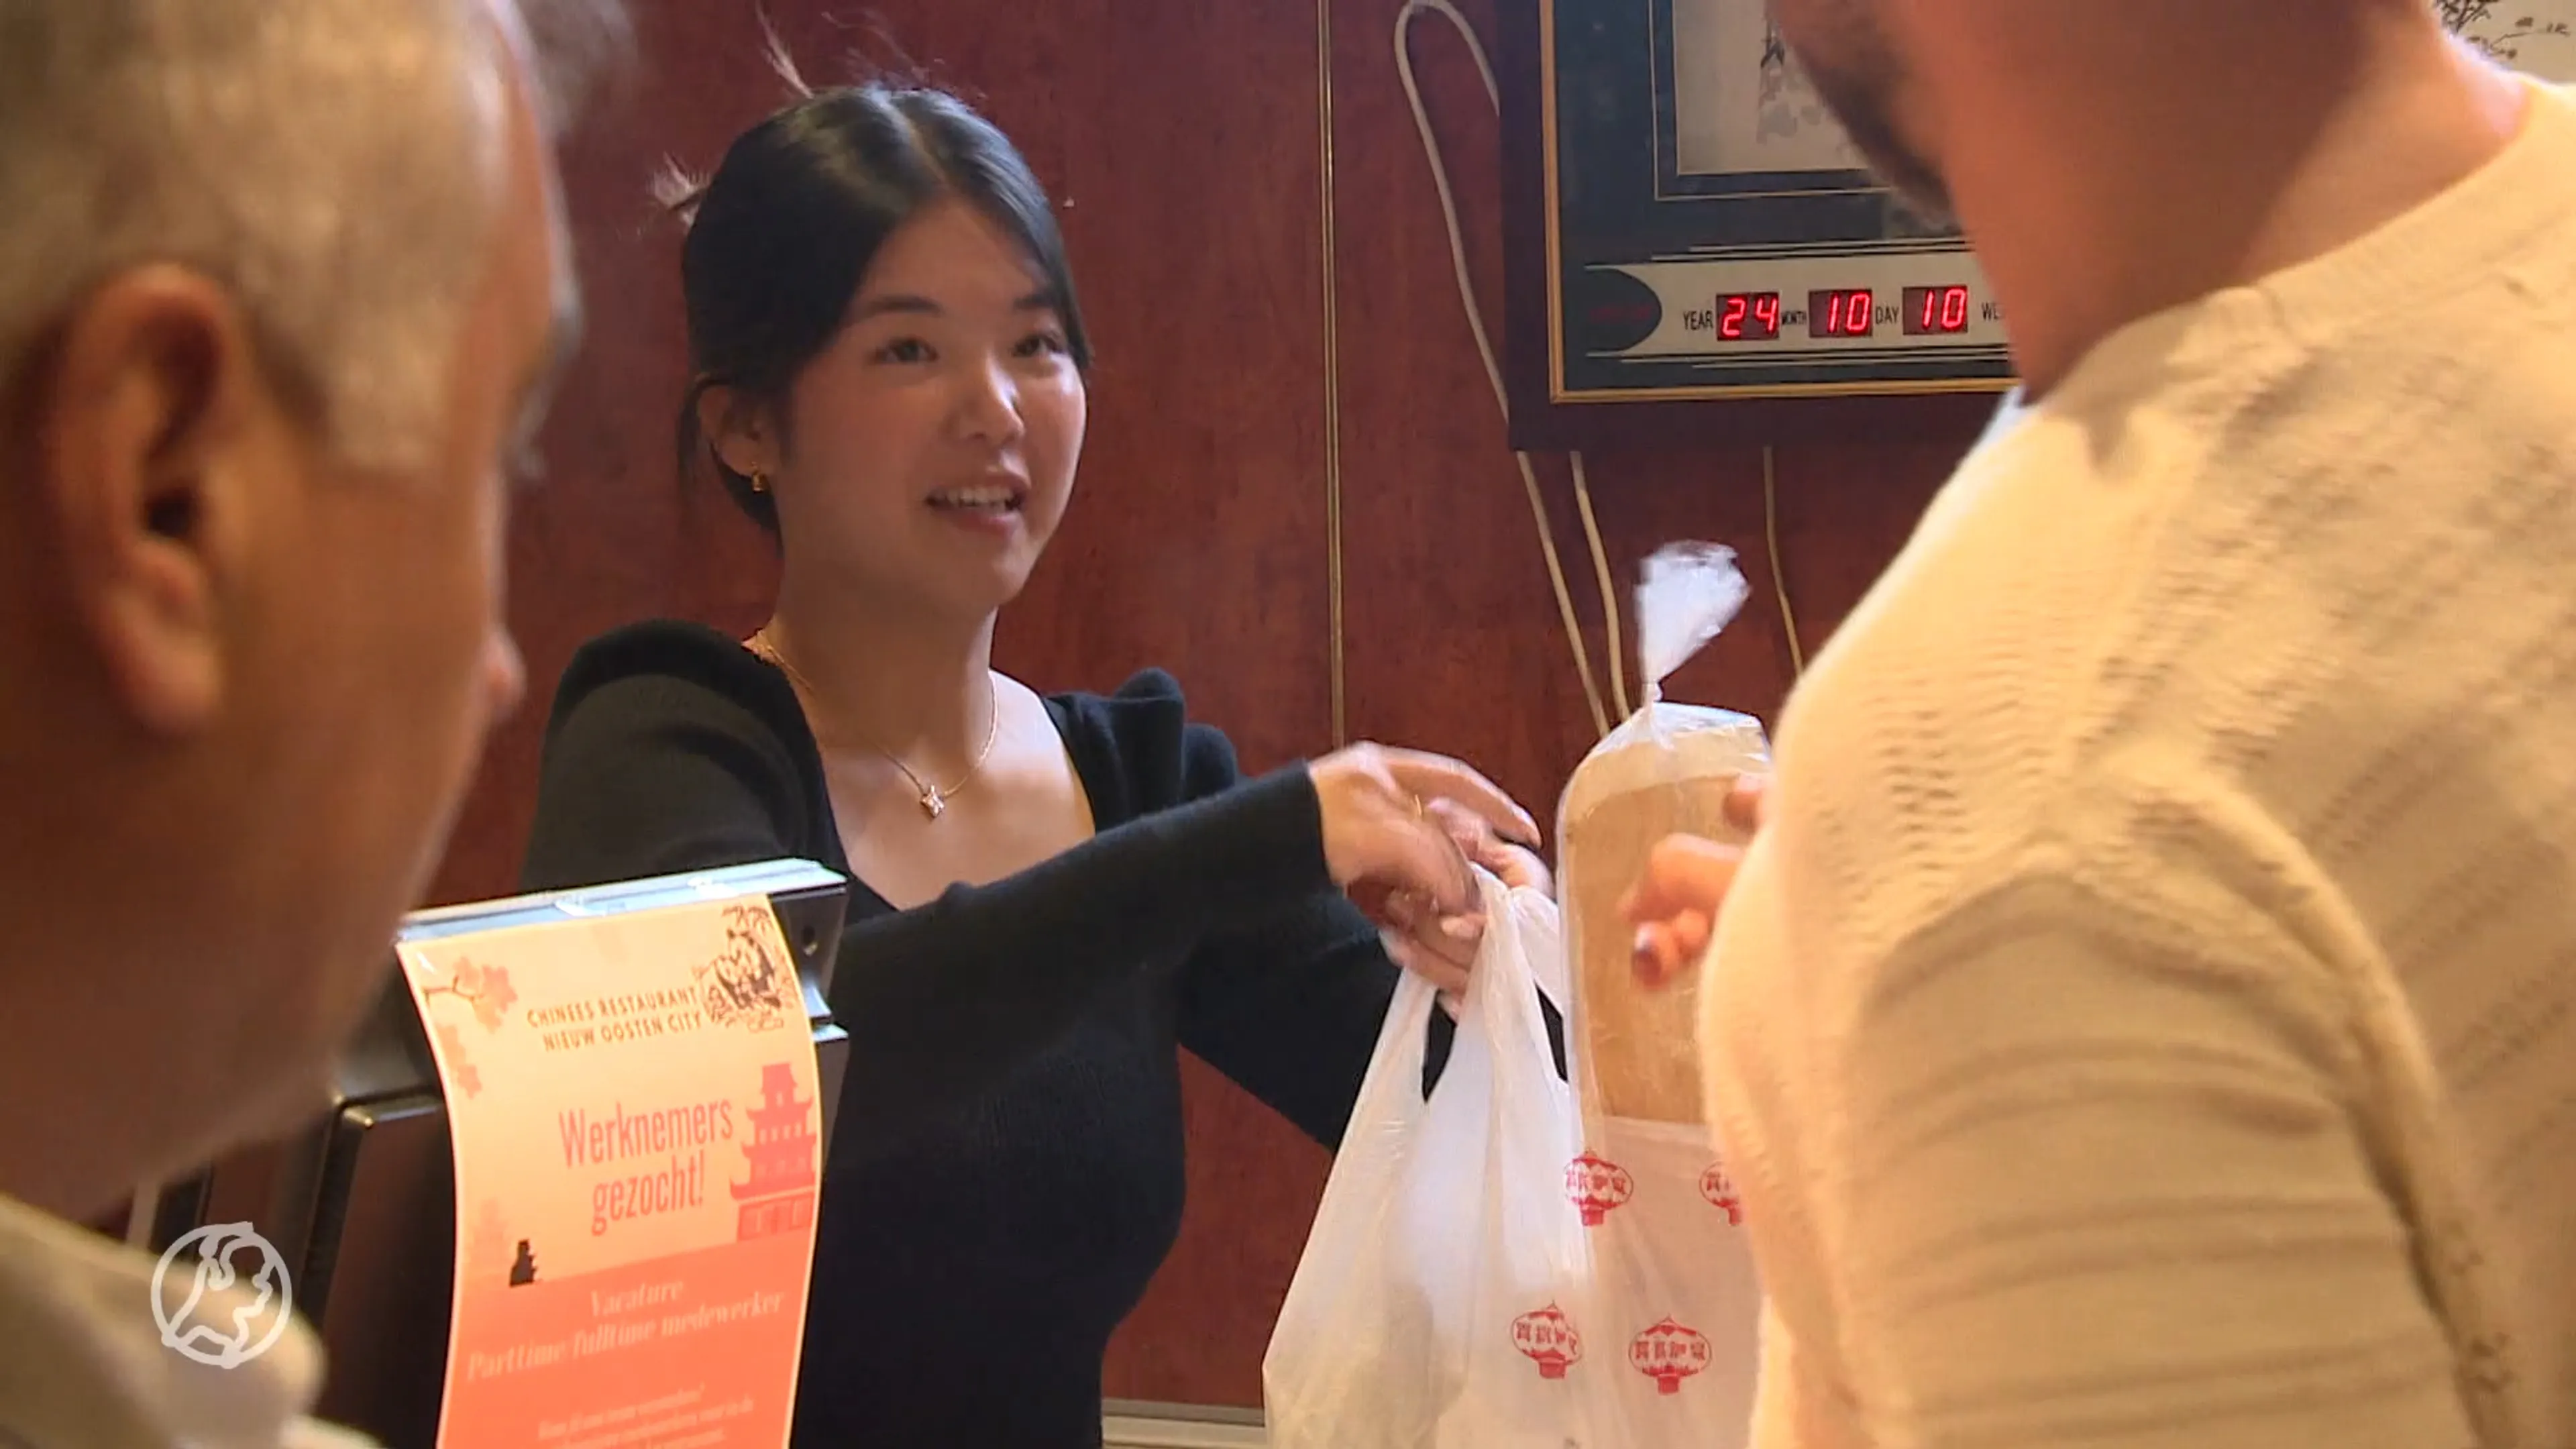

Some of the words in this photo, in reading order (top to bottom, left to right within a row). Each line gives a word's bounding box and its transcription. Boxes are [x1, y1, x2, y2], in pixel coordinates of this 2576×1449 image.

[1682, 311, 1715, 331] YEAR
[1721, 297, 1778, 337] 24
[1781, 311, 1808, 325] MONTH
[1828, 293, 1870, 331] 10
[1876, 305, 1900, 325] DAY
[1922, 287, 1967, 329] 10
[527, 1000, 594, 1028] CHINEES
[598, 986, 698, 1018] RESTAURANT
[542, 1027, 596, 1053] NIEUW
[600, 1016, 663, 1043] OOSTEN
[667, 1010, 701, 1034] CITY
[559, 1100, 733, 1168] Werknemers
[591, 1150, 705, 1236] gezocht!
[590, 1281, 684, 1317] Vacature
[468, 1341, 564, 1381] Parttime
[662, 1291, 784, 1336] medewerker
